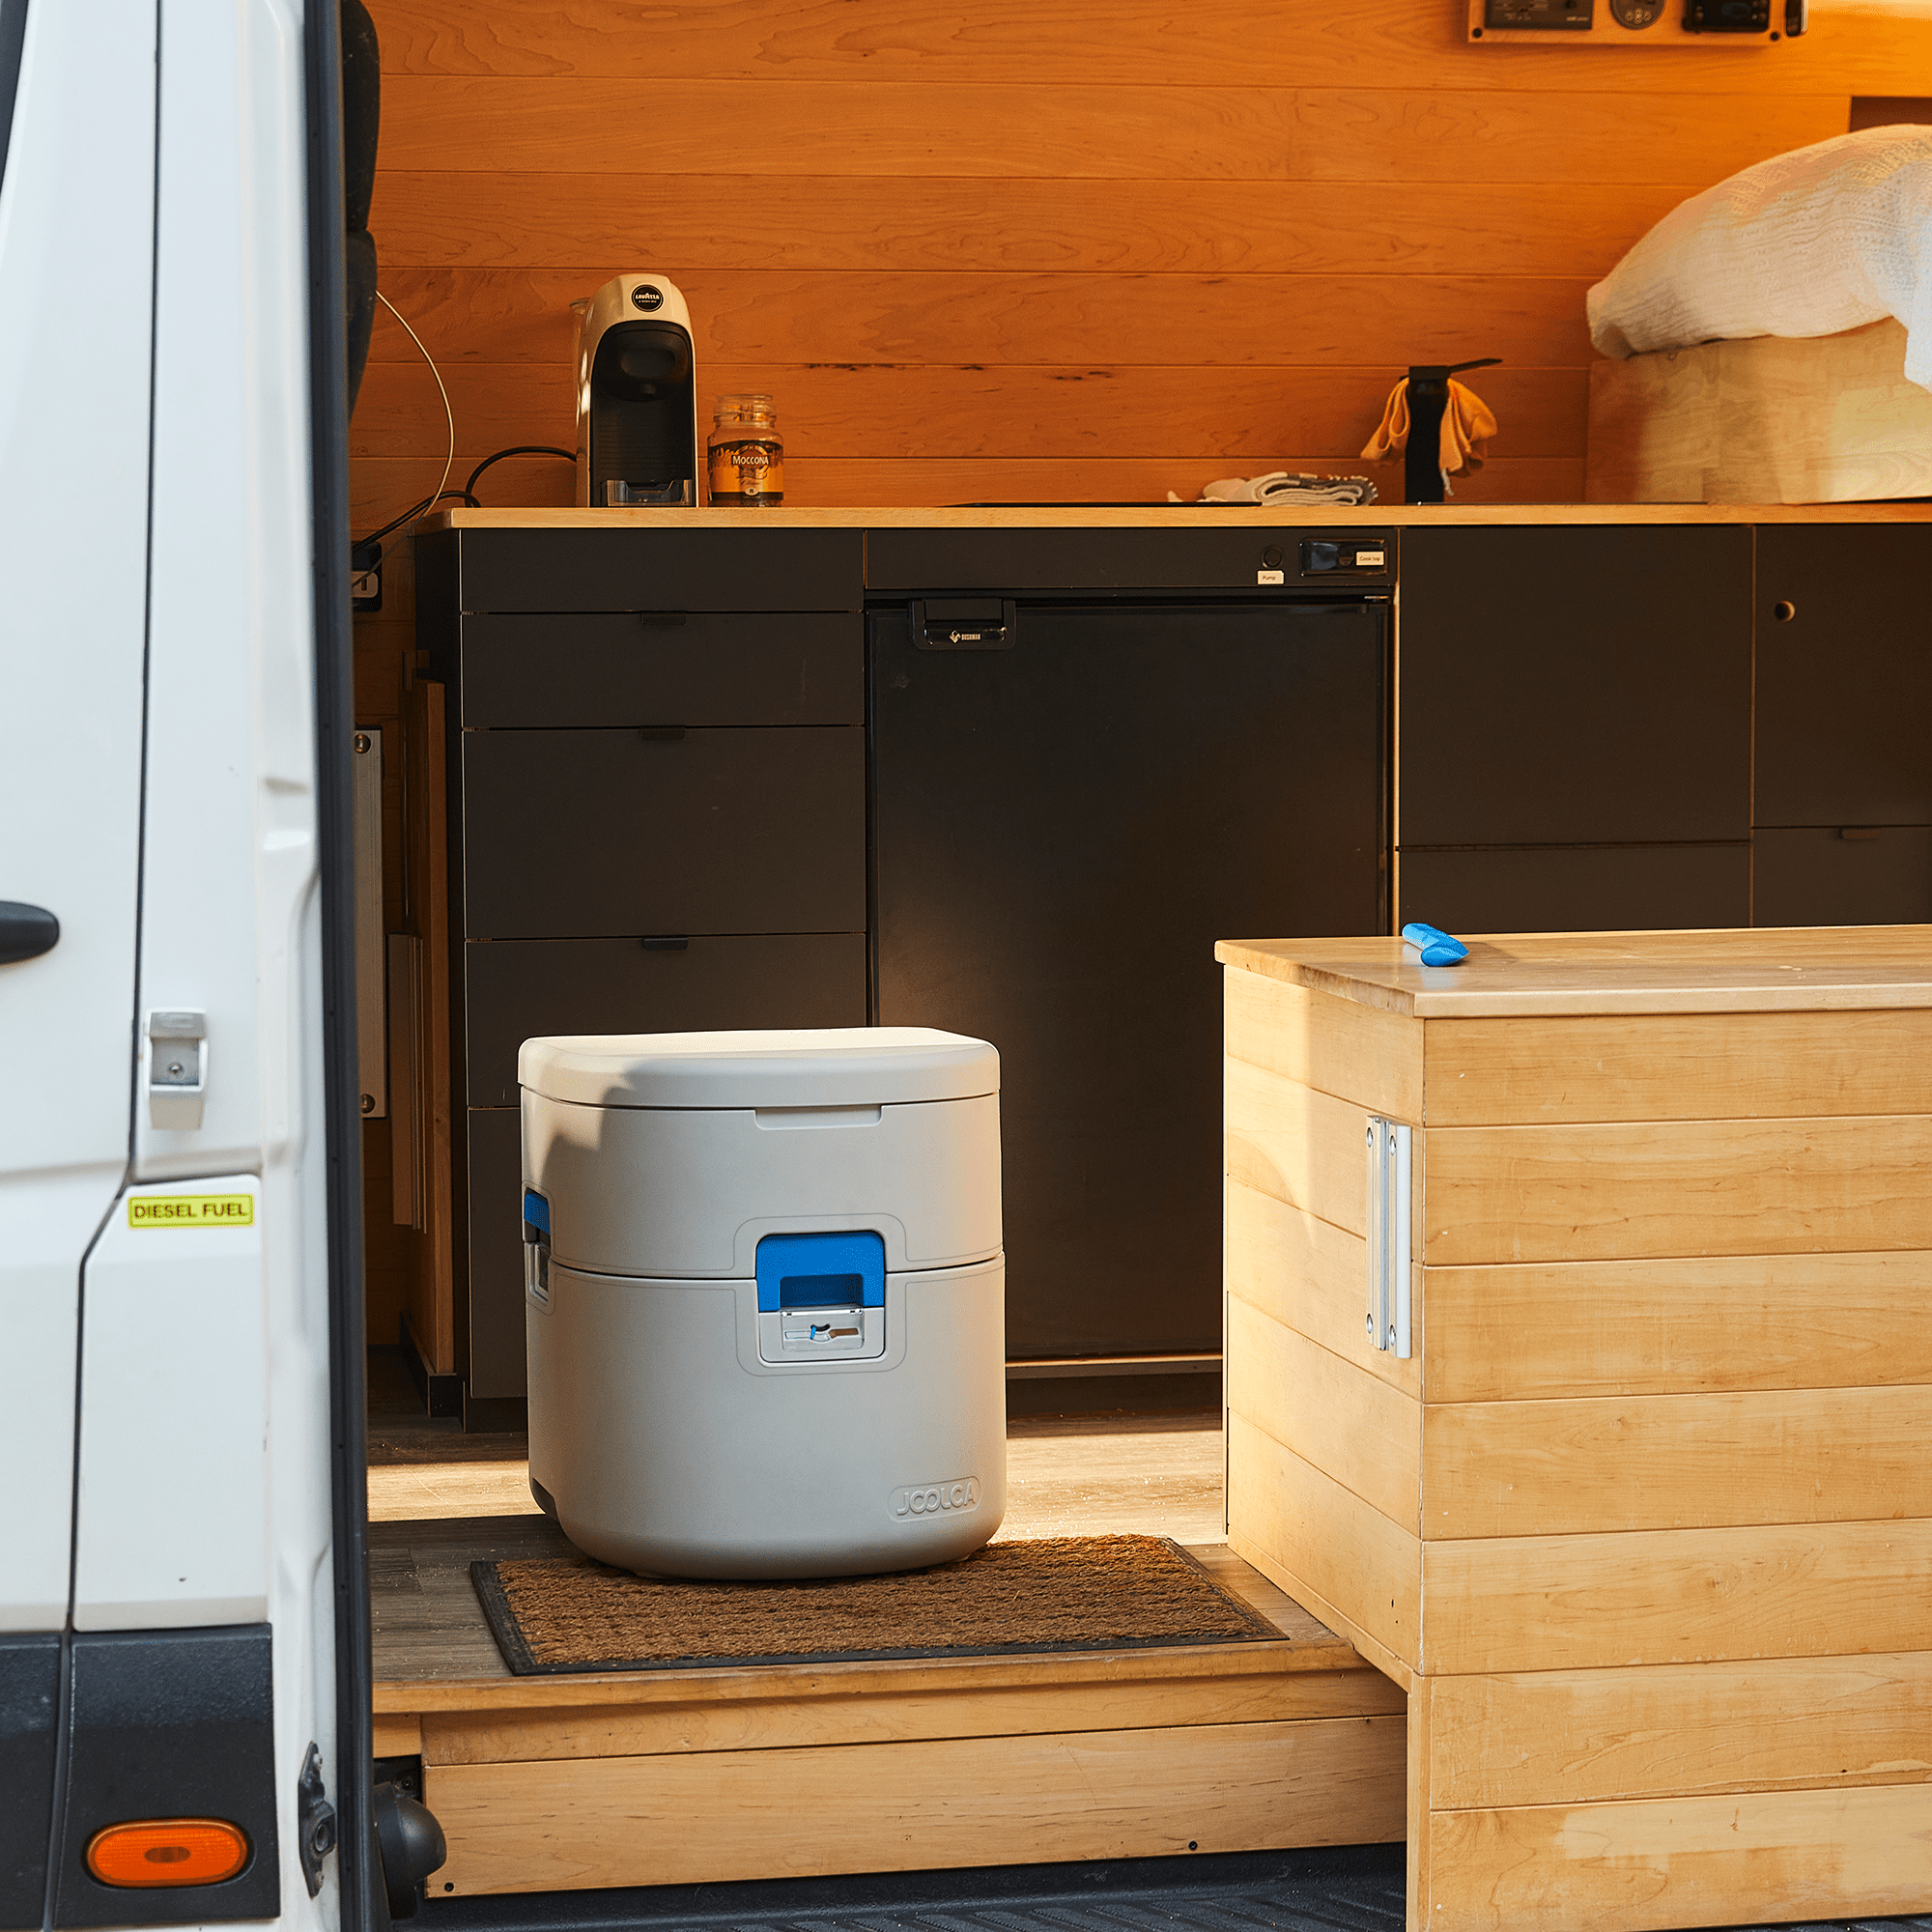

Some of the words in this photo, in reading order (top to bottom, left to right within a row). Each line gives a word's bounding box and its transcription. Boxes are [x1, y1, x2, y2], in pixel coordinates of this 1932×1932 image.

[732, 456, 769, 465] MOCCONA
[134, 1204, 198, 1219] DIESEL
[202, 1203, 247, 1217] FUEL
[895, 1482, 976, 1517] JOOLCA
